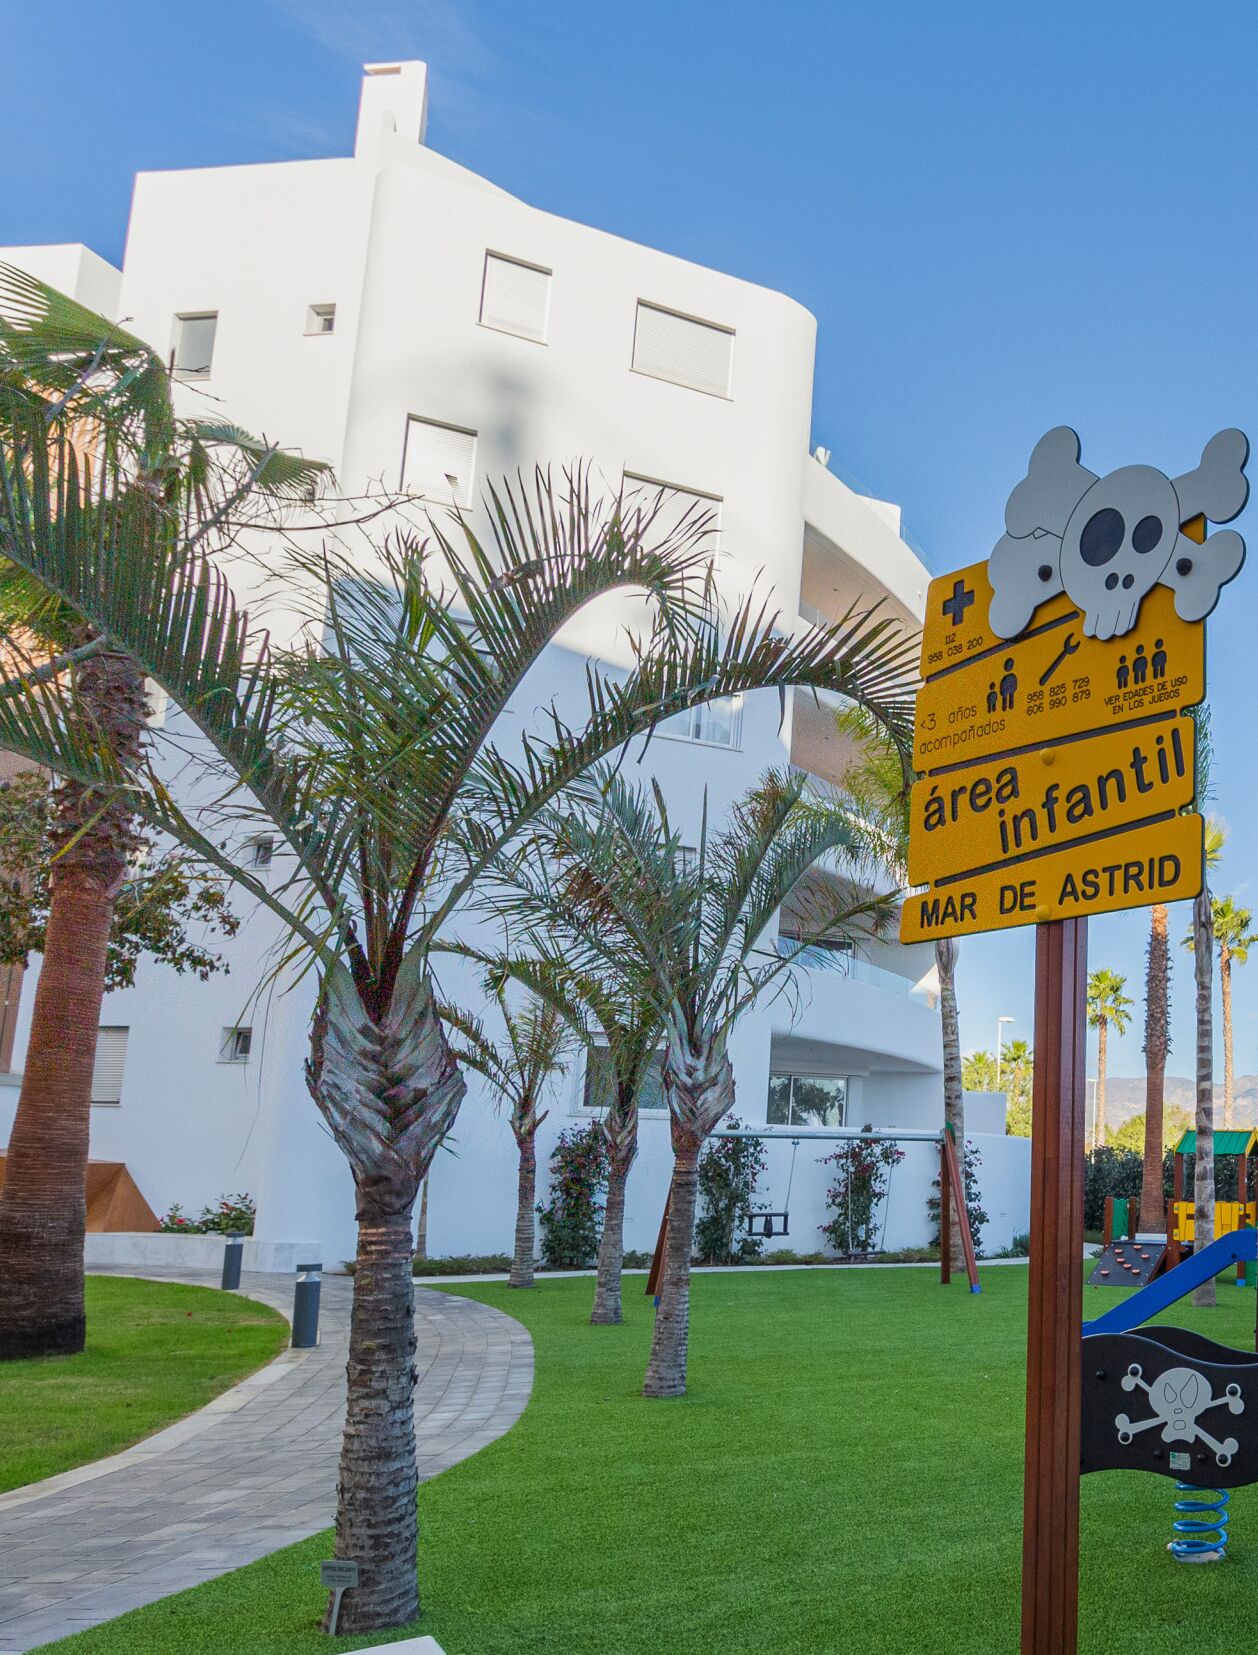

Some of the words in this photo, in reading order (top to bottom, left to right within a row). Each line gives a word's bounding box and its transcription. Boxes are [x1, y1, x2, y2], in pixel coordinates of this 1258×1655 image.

[945, 632, 957, 645] 112
[947, 643, 963, 657] 038
[967, 636, 984, 650] 200
[1026, 702, 1044, 716] 606
[1049, 695, 1068, 710] 990
[1072, 688, 1091, 703] 879
[1027, 690, 1045, 704] 958
[1049, 683, 1067, 697] 825
[1072, 676, 1090, 690] 729
[1104, 694, 1121, 706] VER
[1122, 684, 1155, 702] EDADES
[1157, 681, 1168, 692] DE
[1170, 675, 1188, 688] USO
[1112, 703, 1124, 715] EN
[1128, 698, 1144, 711] LOS
[1149, 688, 1181, 705] JUEGOS
[948, 705, 978, 724] años
[919, 719, 1006, 755] acompañados
[923, 766, 1020, 832] área
[998, 727, 1186, 855] infantil
[919, 891, 978, 929] MAR
[999, 879, 1037, 915] DE
[1058, 853, 1182, 906] ASTRID
